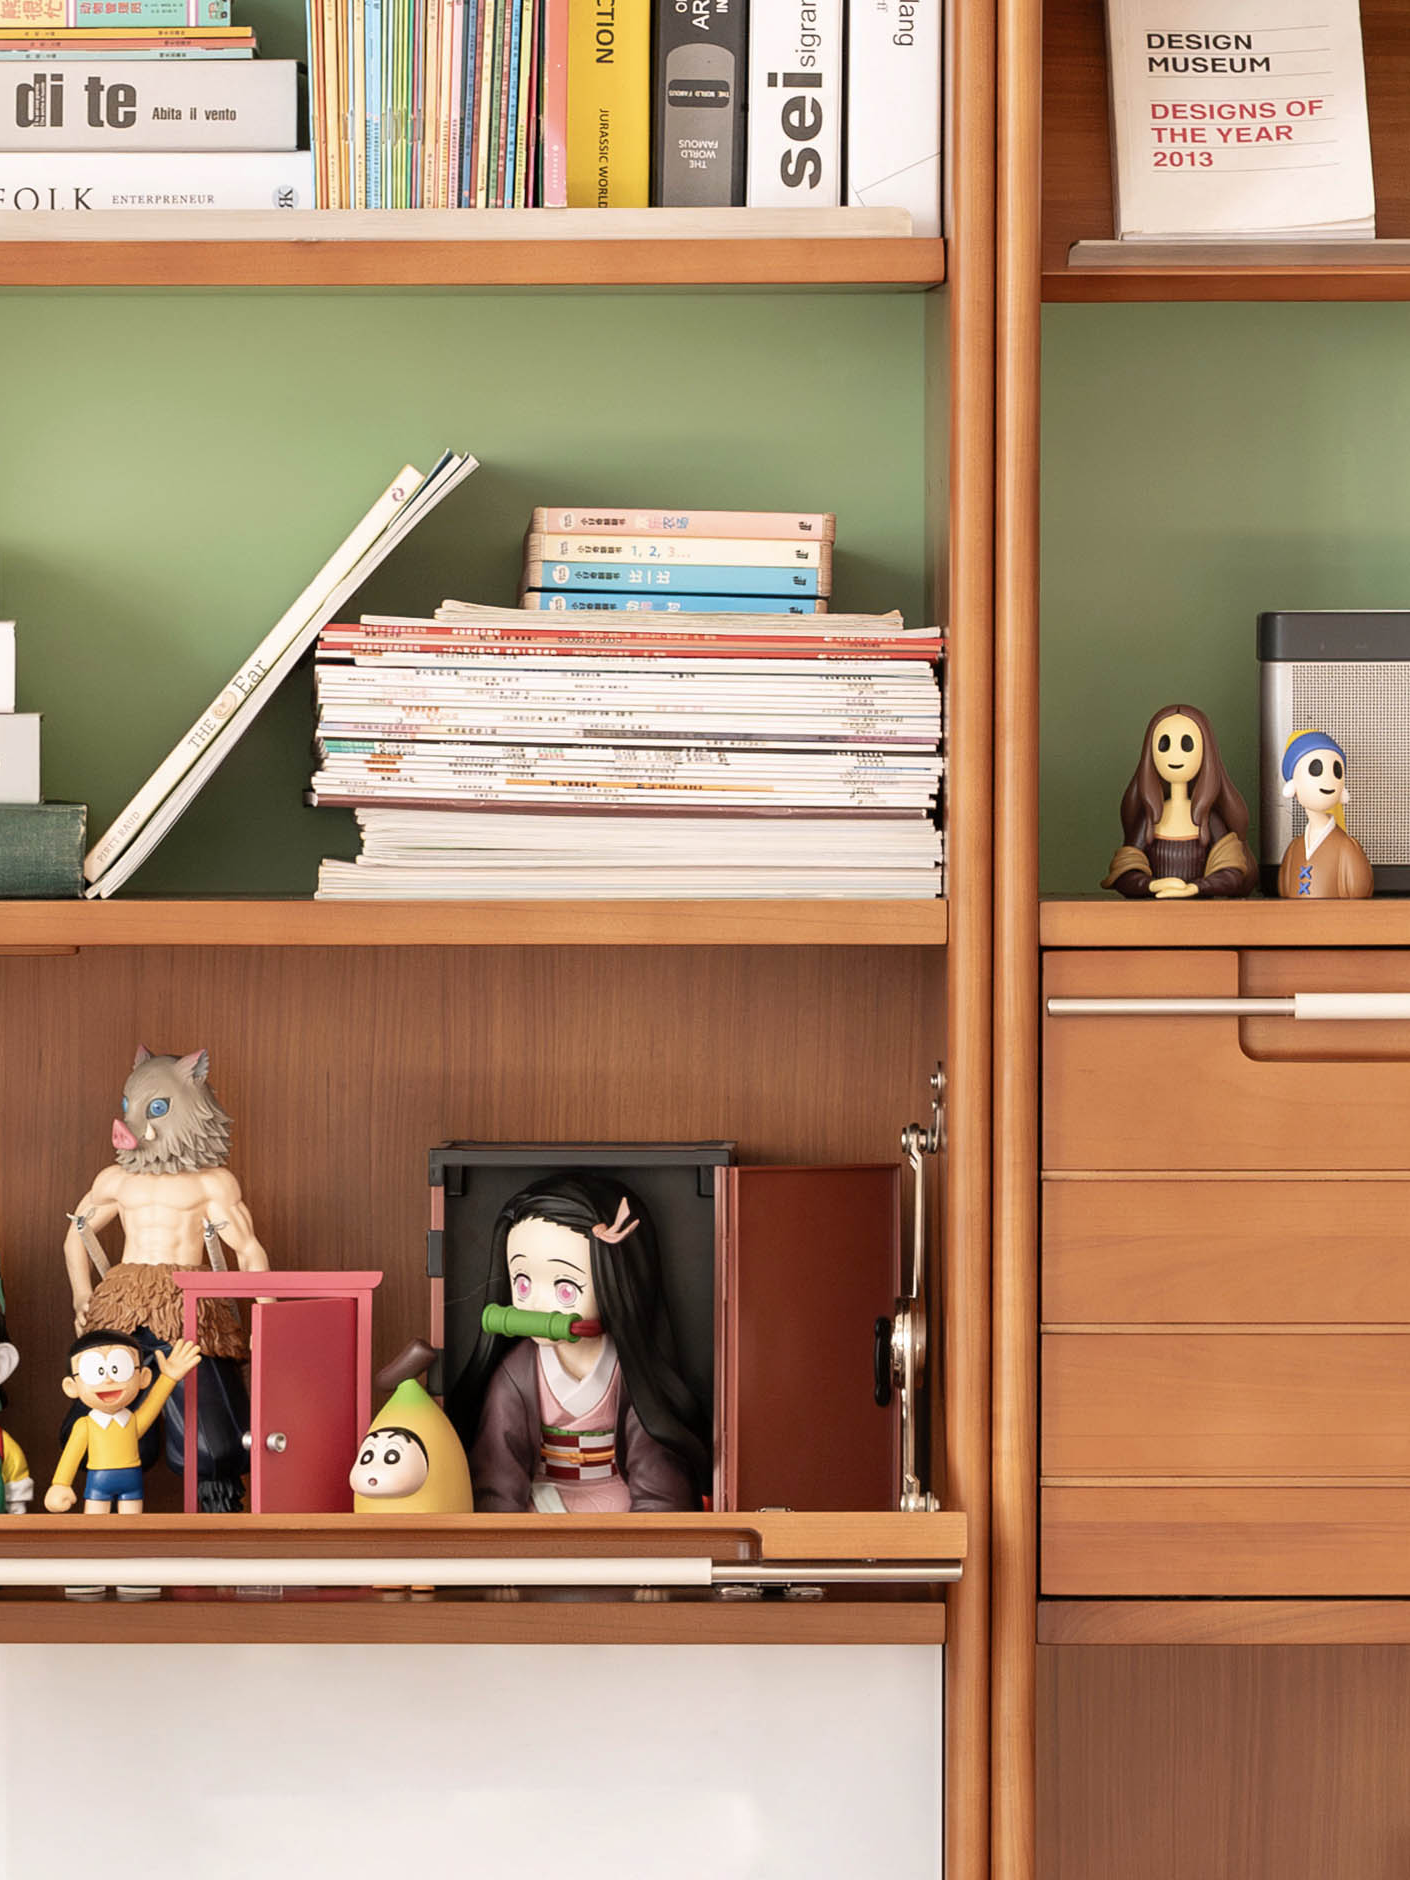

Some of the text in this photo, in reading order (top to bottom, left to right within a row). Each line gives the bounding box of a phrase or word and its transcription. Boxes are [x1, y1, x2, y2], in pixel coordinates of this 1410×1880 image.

[1146, 33, 1253, 50] DESIGN
[1147, 56, 1271, 73] MUSEUM
[16, 73, 64, 128] di
[85, 76, 137, 129] te
[152, 107, 182, 121] Abita
[189, 107, 198, 121] il
[204, 110, 237, 121] vento
[1150, 99, 1324, 120] DESIGNS OF
[599, 108, 609, 163] JURASSIC
[767, 72, 823, 189] sei
[1151, 125, 1293, 143] THE YEAR
[678, 139, 718, 149] FAMOUS
[680, 151, 716, 159] WORLD
[1153, 151, 1214, 167] 2013
[689, 160, 707, 169] THE
[628, 569, 671, 586] 比一比
[188, 659, 268, 748] THE Ear
[97, 811, 141, 863] PIRET RAUD
